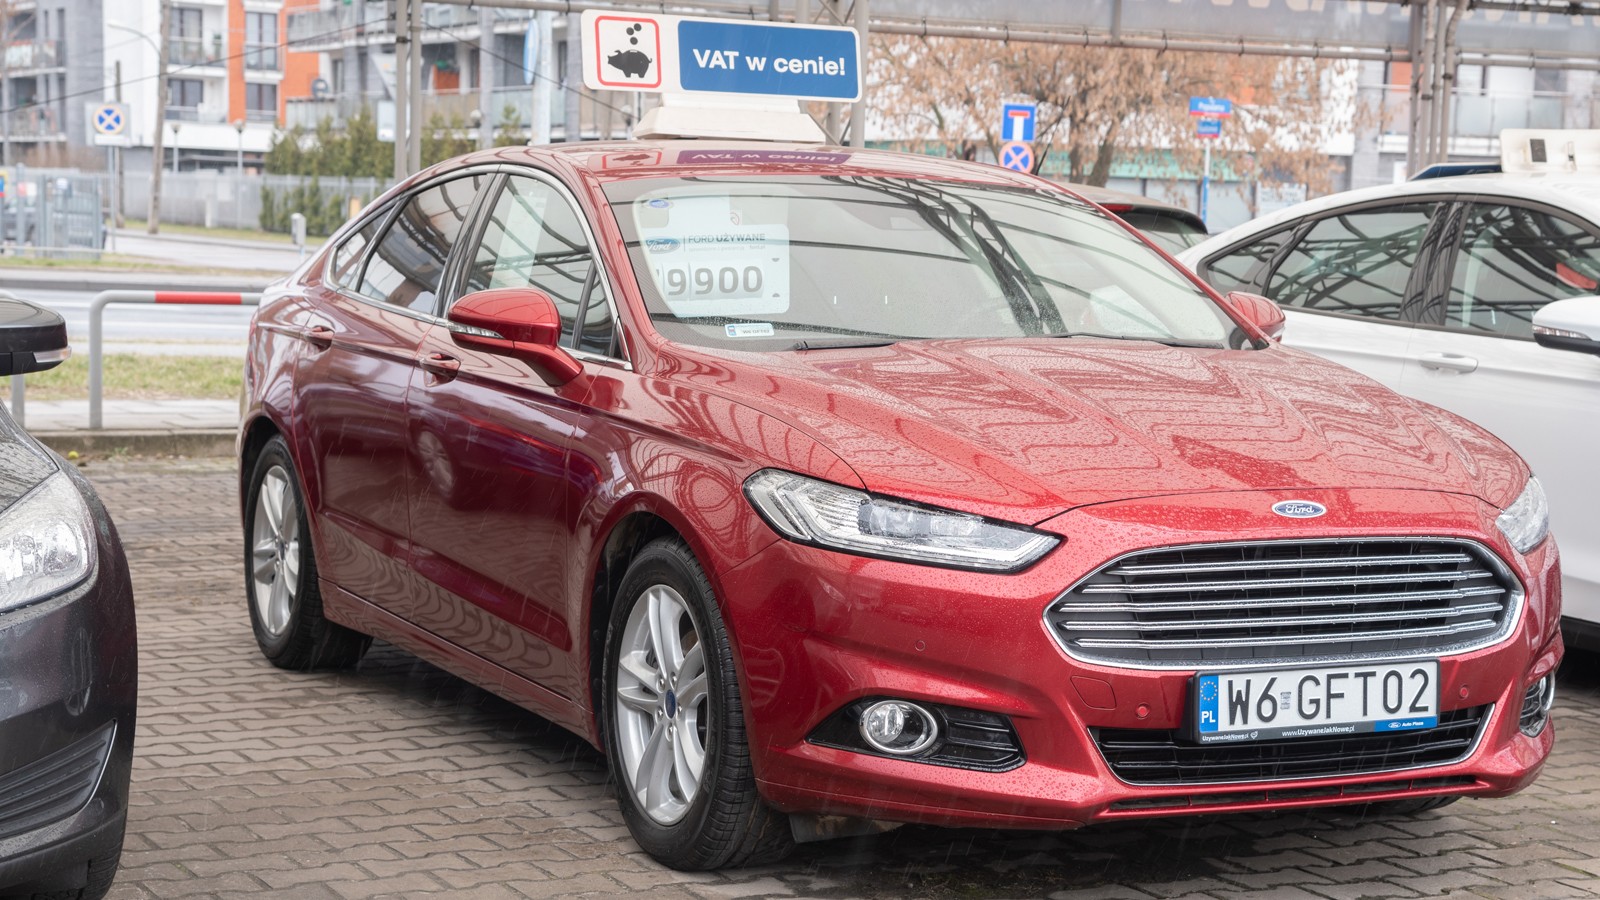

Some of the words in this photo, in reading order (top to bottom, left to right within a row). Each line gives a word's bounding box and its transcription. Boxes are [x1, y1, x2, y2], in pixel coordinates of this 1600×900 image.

[692, 48, 740, 70] VAT
[745, 56, 767, 71] w
[773, 57, 847, 76] cenie!
[688, 234, 715, 243] FORD
[716, 232, 766, 243] UŻYWANE
[1227, 676, 1278, 726] W6
[1297, 668, 1430, 720] GFT02
[1201, 710, 1216, 724] PL
